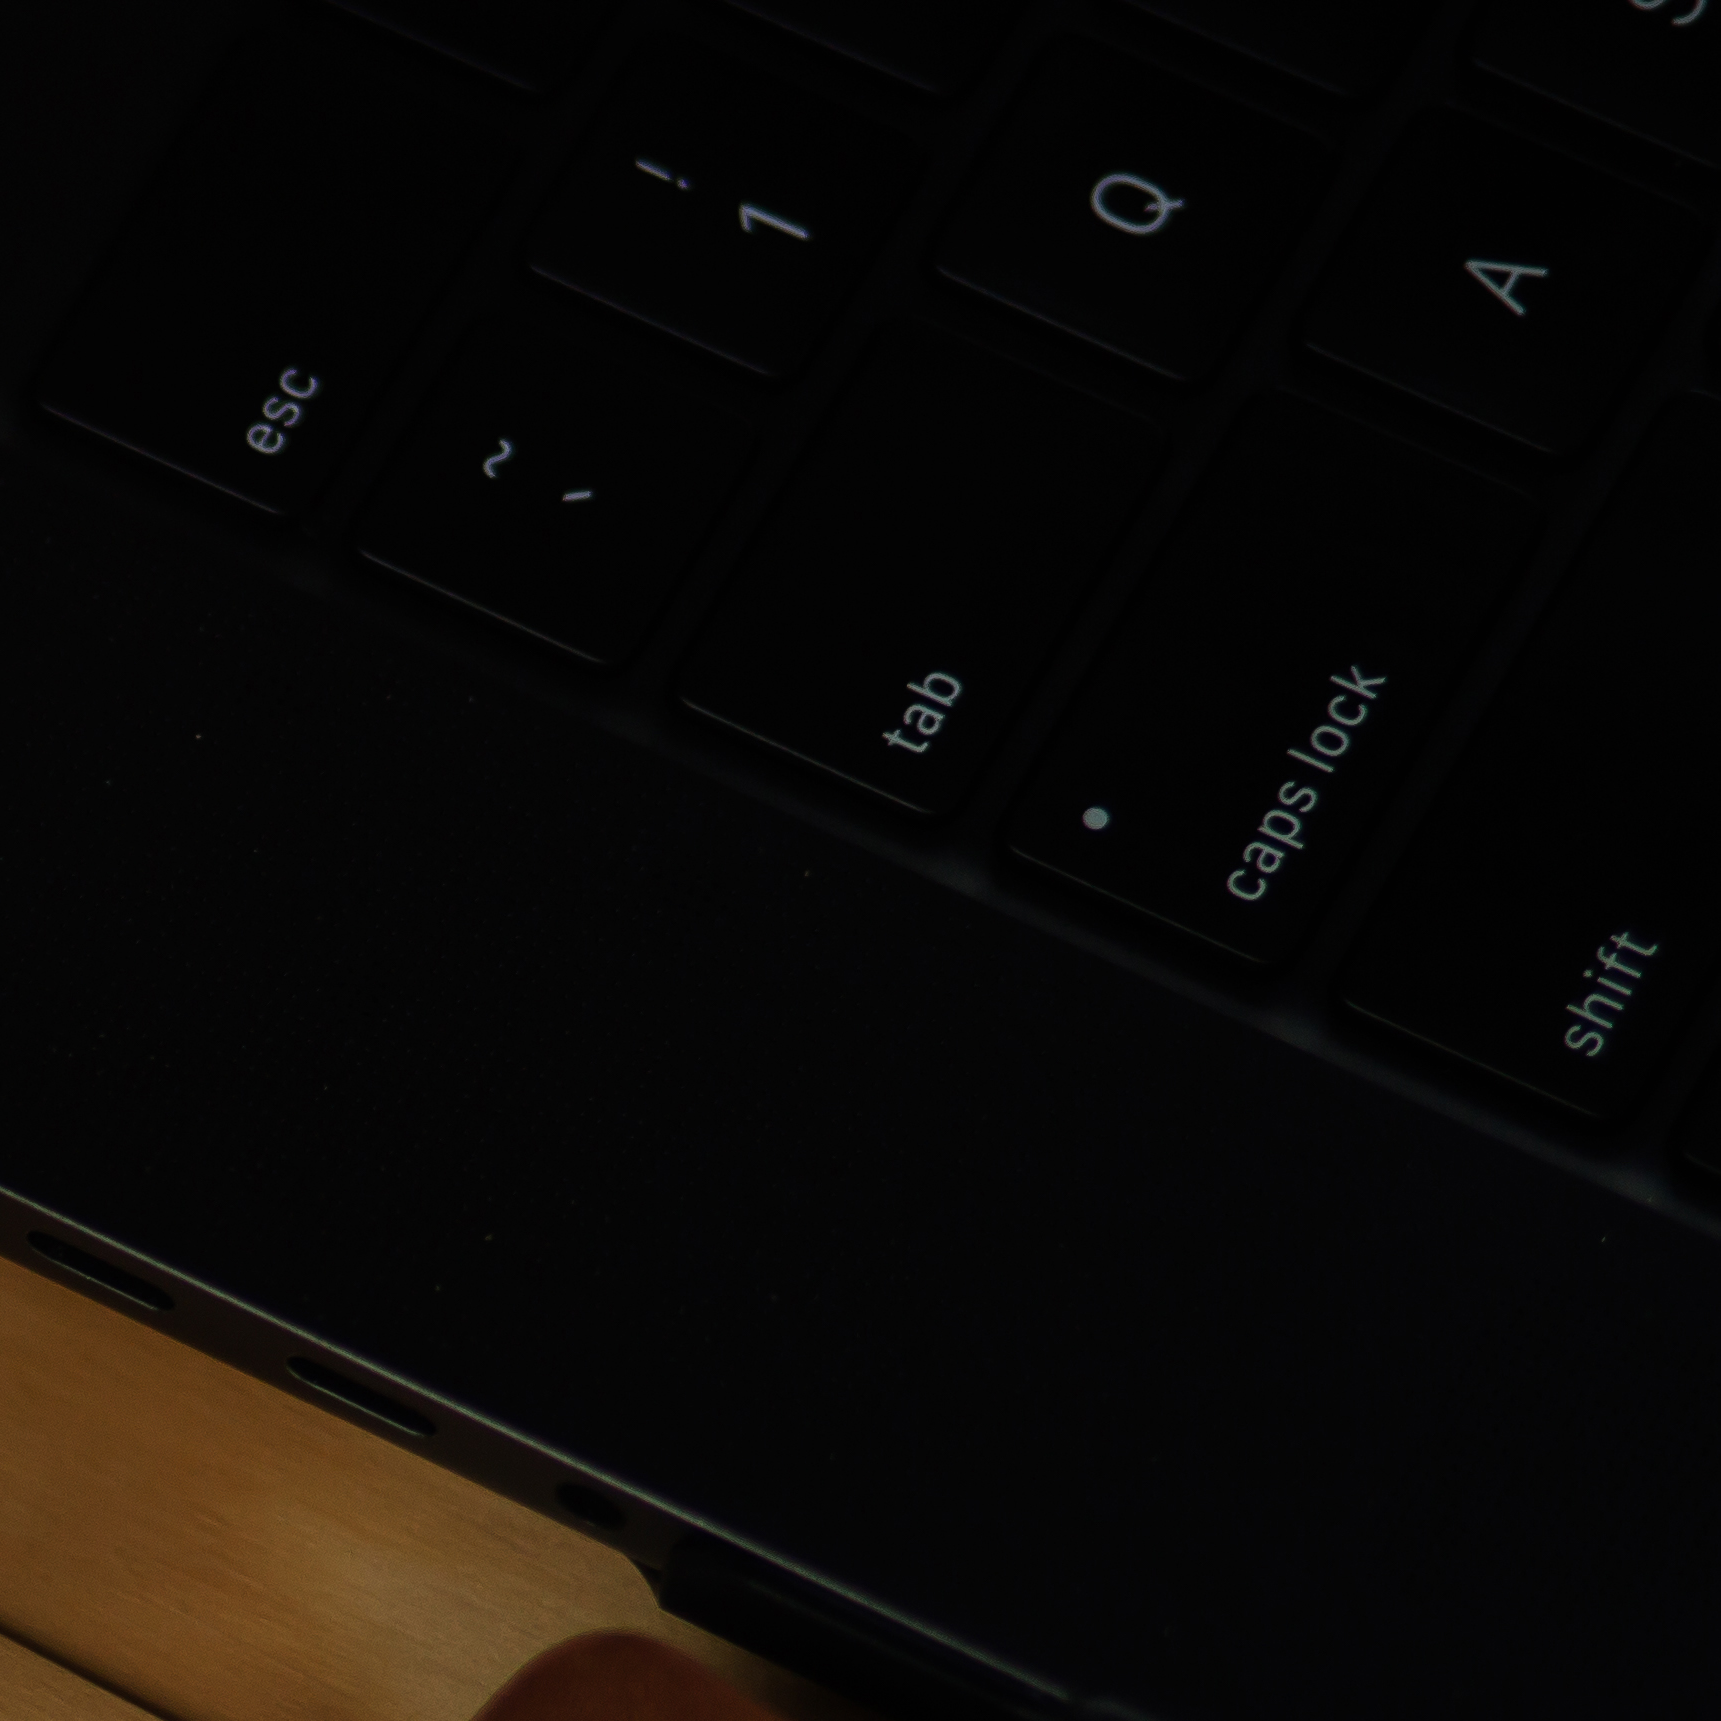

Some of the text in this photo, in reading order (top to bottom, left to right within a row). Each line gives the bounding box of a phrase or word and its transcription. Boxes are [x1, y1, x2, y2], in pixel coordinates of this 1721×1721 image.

[737, 202, 812, 241] 1
[1089, 171, 1186, 236] Q
[1463, 258, 1549, 317] A
[245, 366, 321, 456] esc
[880, 669, 963, 754] tab
[1225, 664, 1387, 902] caps lock
[1563, 930, 1659, 1058] shift
